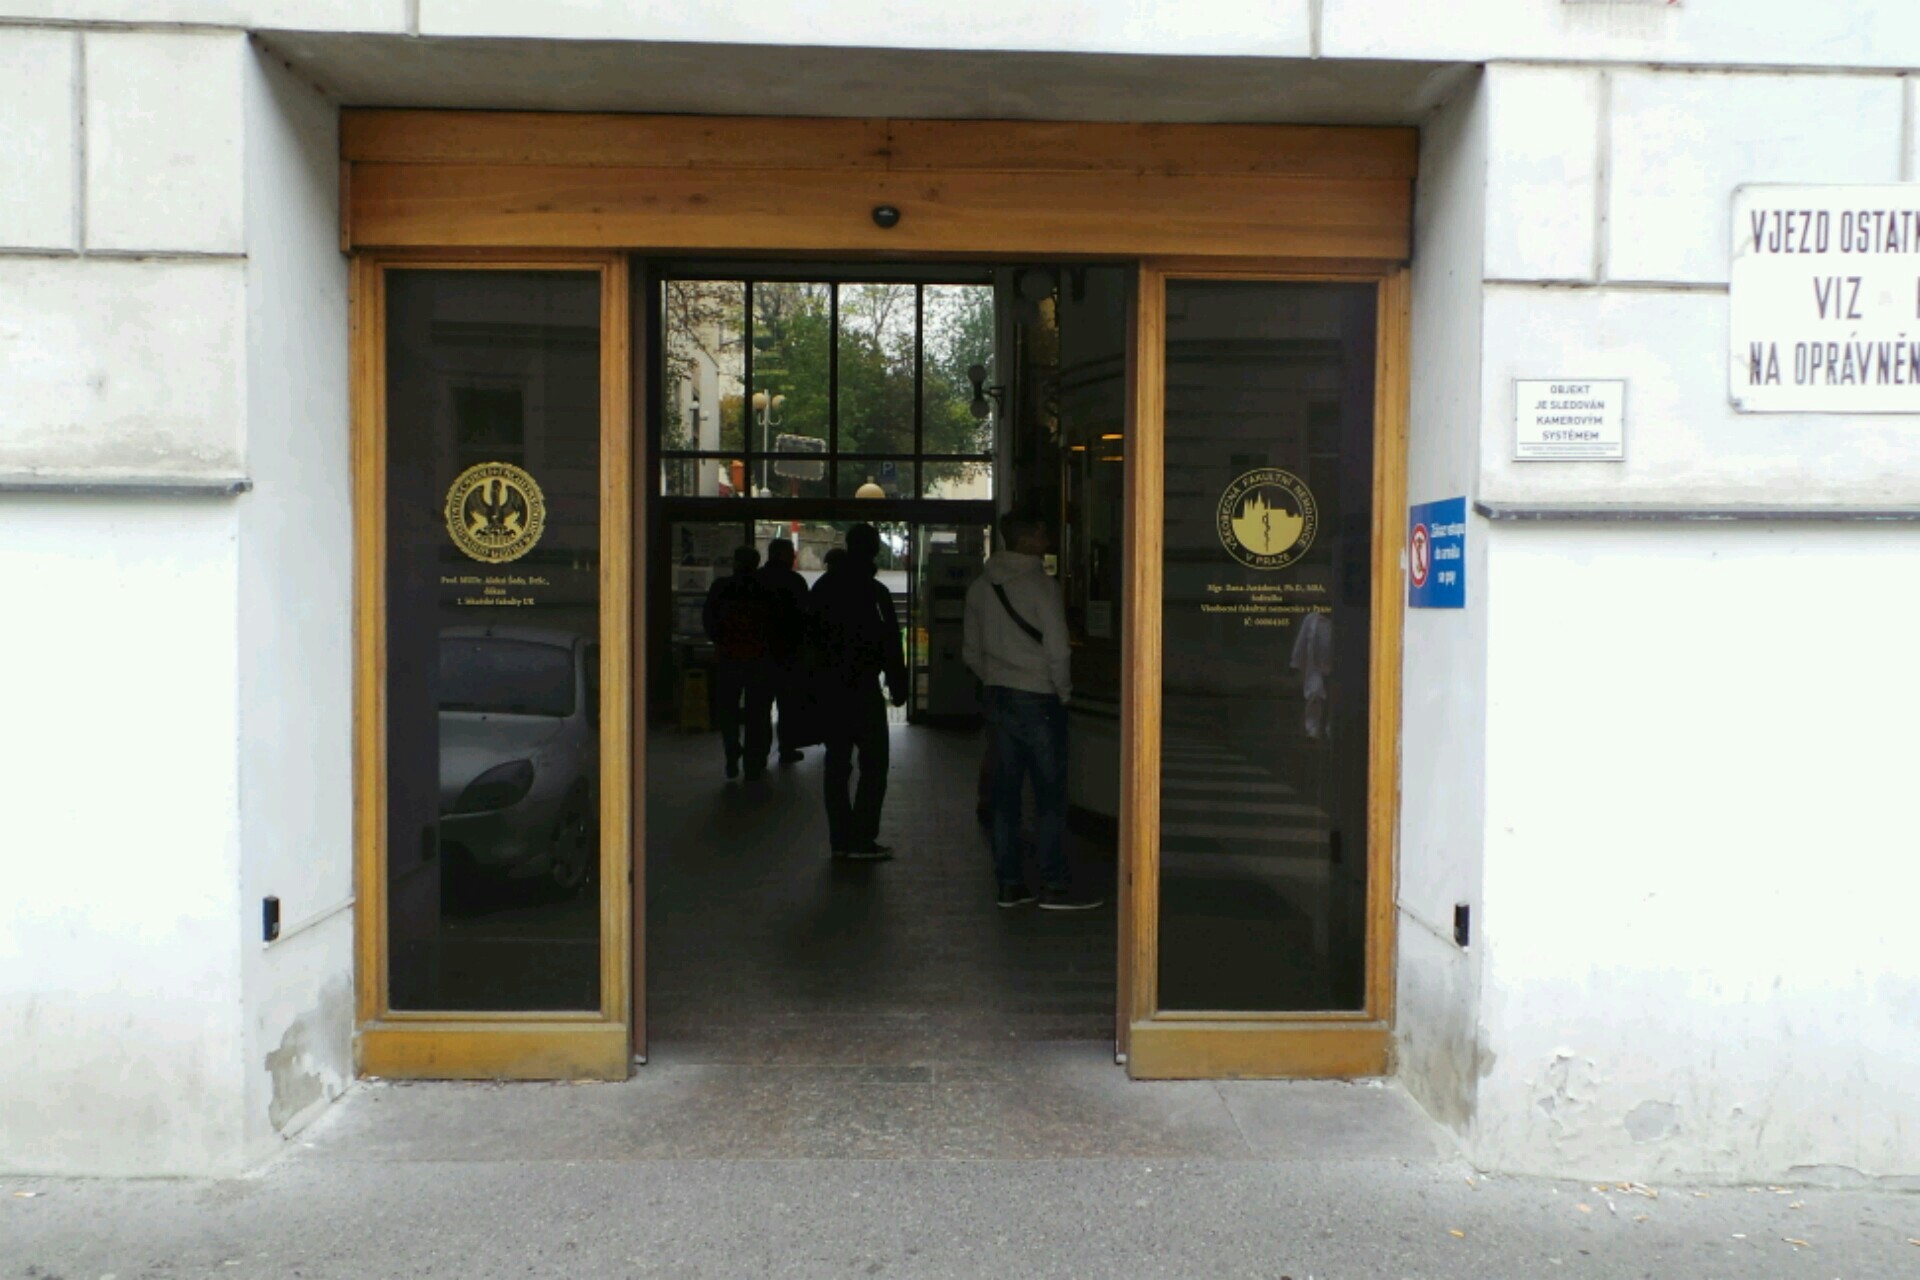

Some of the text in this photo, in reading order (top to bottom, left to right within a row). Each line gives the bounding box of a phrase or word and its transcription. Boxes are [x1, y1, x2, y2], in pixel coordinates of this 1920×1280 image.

[1751, 210, 1830, 253] VJEZD
[1813, 276, 1862, 319] VIZ
[1749, 331, 1920, 385] NA OPRÁVNĚN
[1550, 384, 1591, 395] OBJEKT
[1535, 398, 1605, 410] JE SLEDOVÁN
[1536, 414, 1603, 426] KAMEROVÝM
[1542, 429, 1600, 441] SYSTÉMEM
